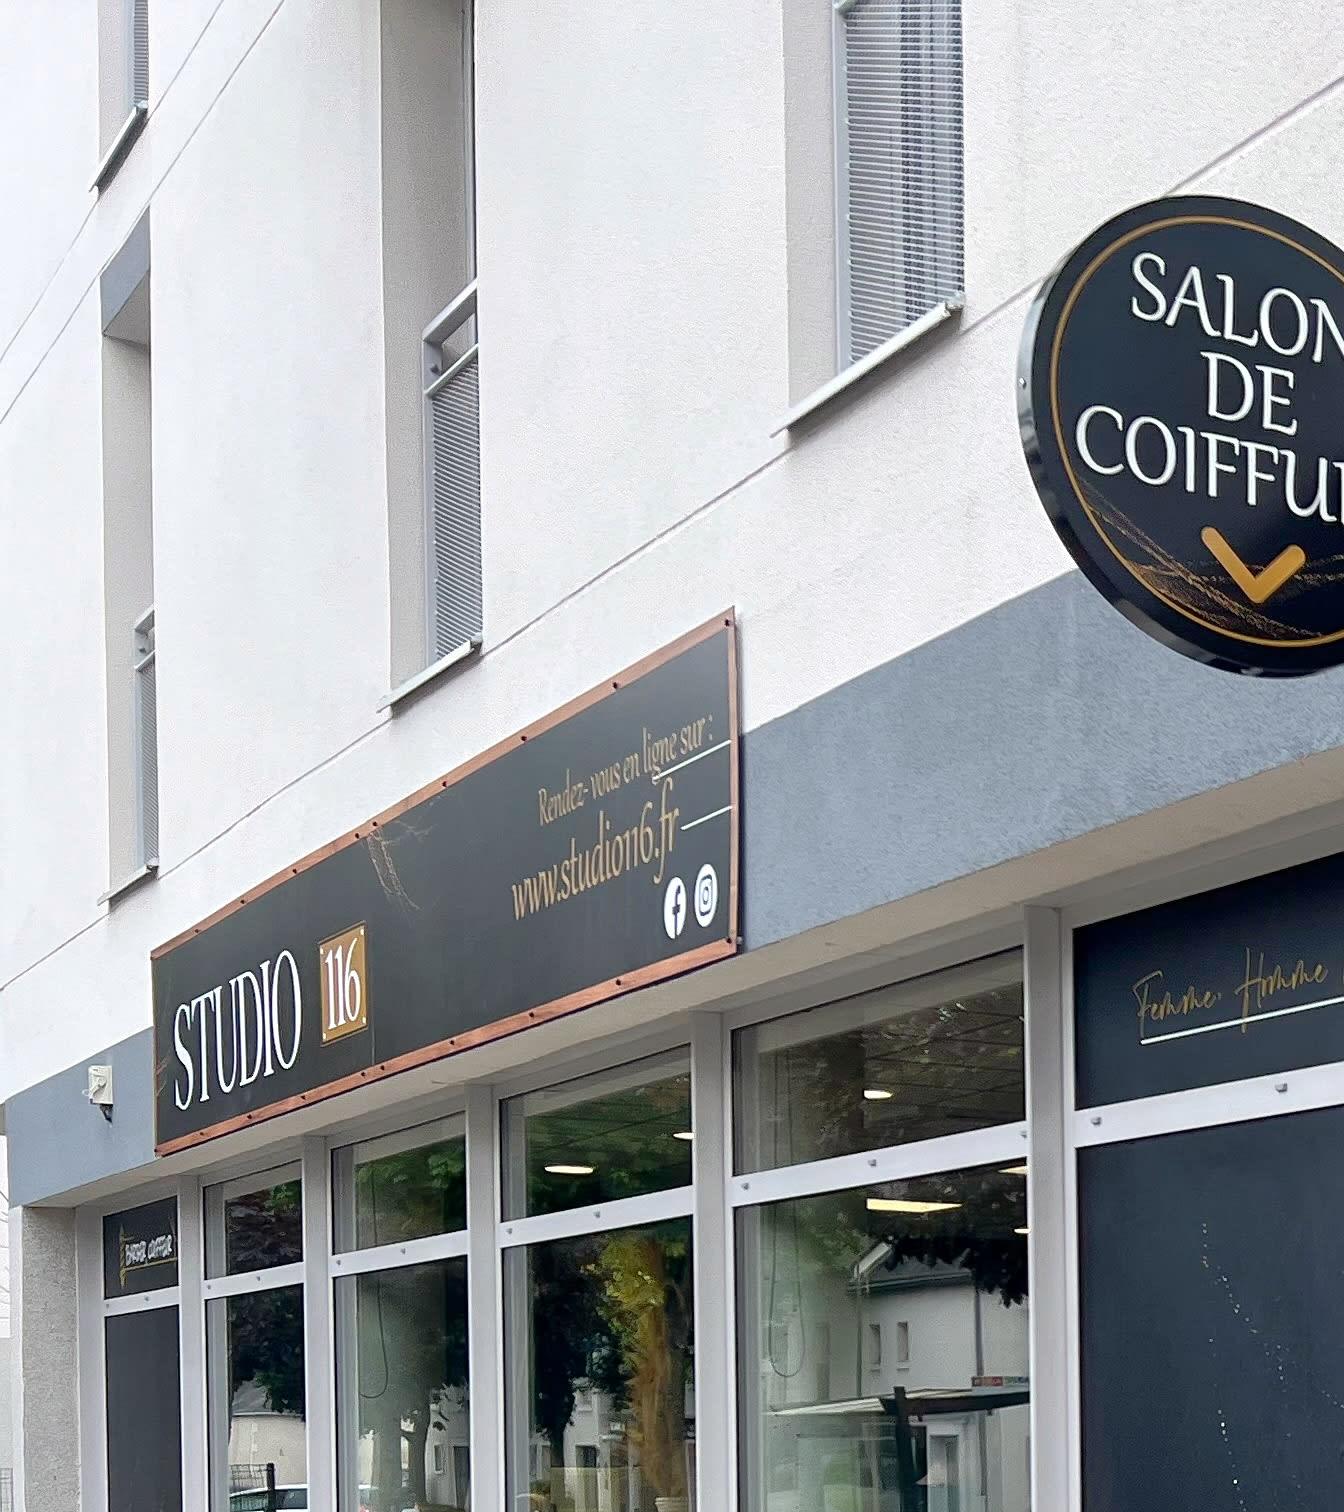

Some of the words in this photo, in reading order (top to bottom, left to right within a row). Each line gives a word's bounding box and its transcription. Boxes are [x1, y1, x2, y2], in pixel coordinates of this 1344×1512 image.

[1200, 350, 1298, 436] DE
[591, 761, 621, 800] vous
[623, 752, 640, 784] en
[643, 727, 677, 785] ligne
[680, 717, 705, 754] sur
[511, 777, 680, 920] www.studio116.fr
[173, 949, 303, 1112] STUDIO
[325, 938, 362, 1030] 116
[1234, 947, 1328, 1032] Homme
